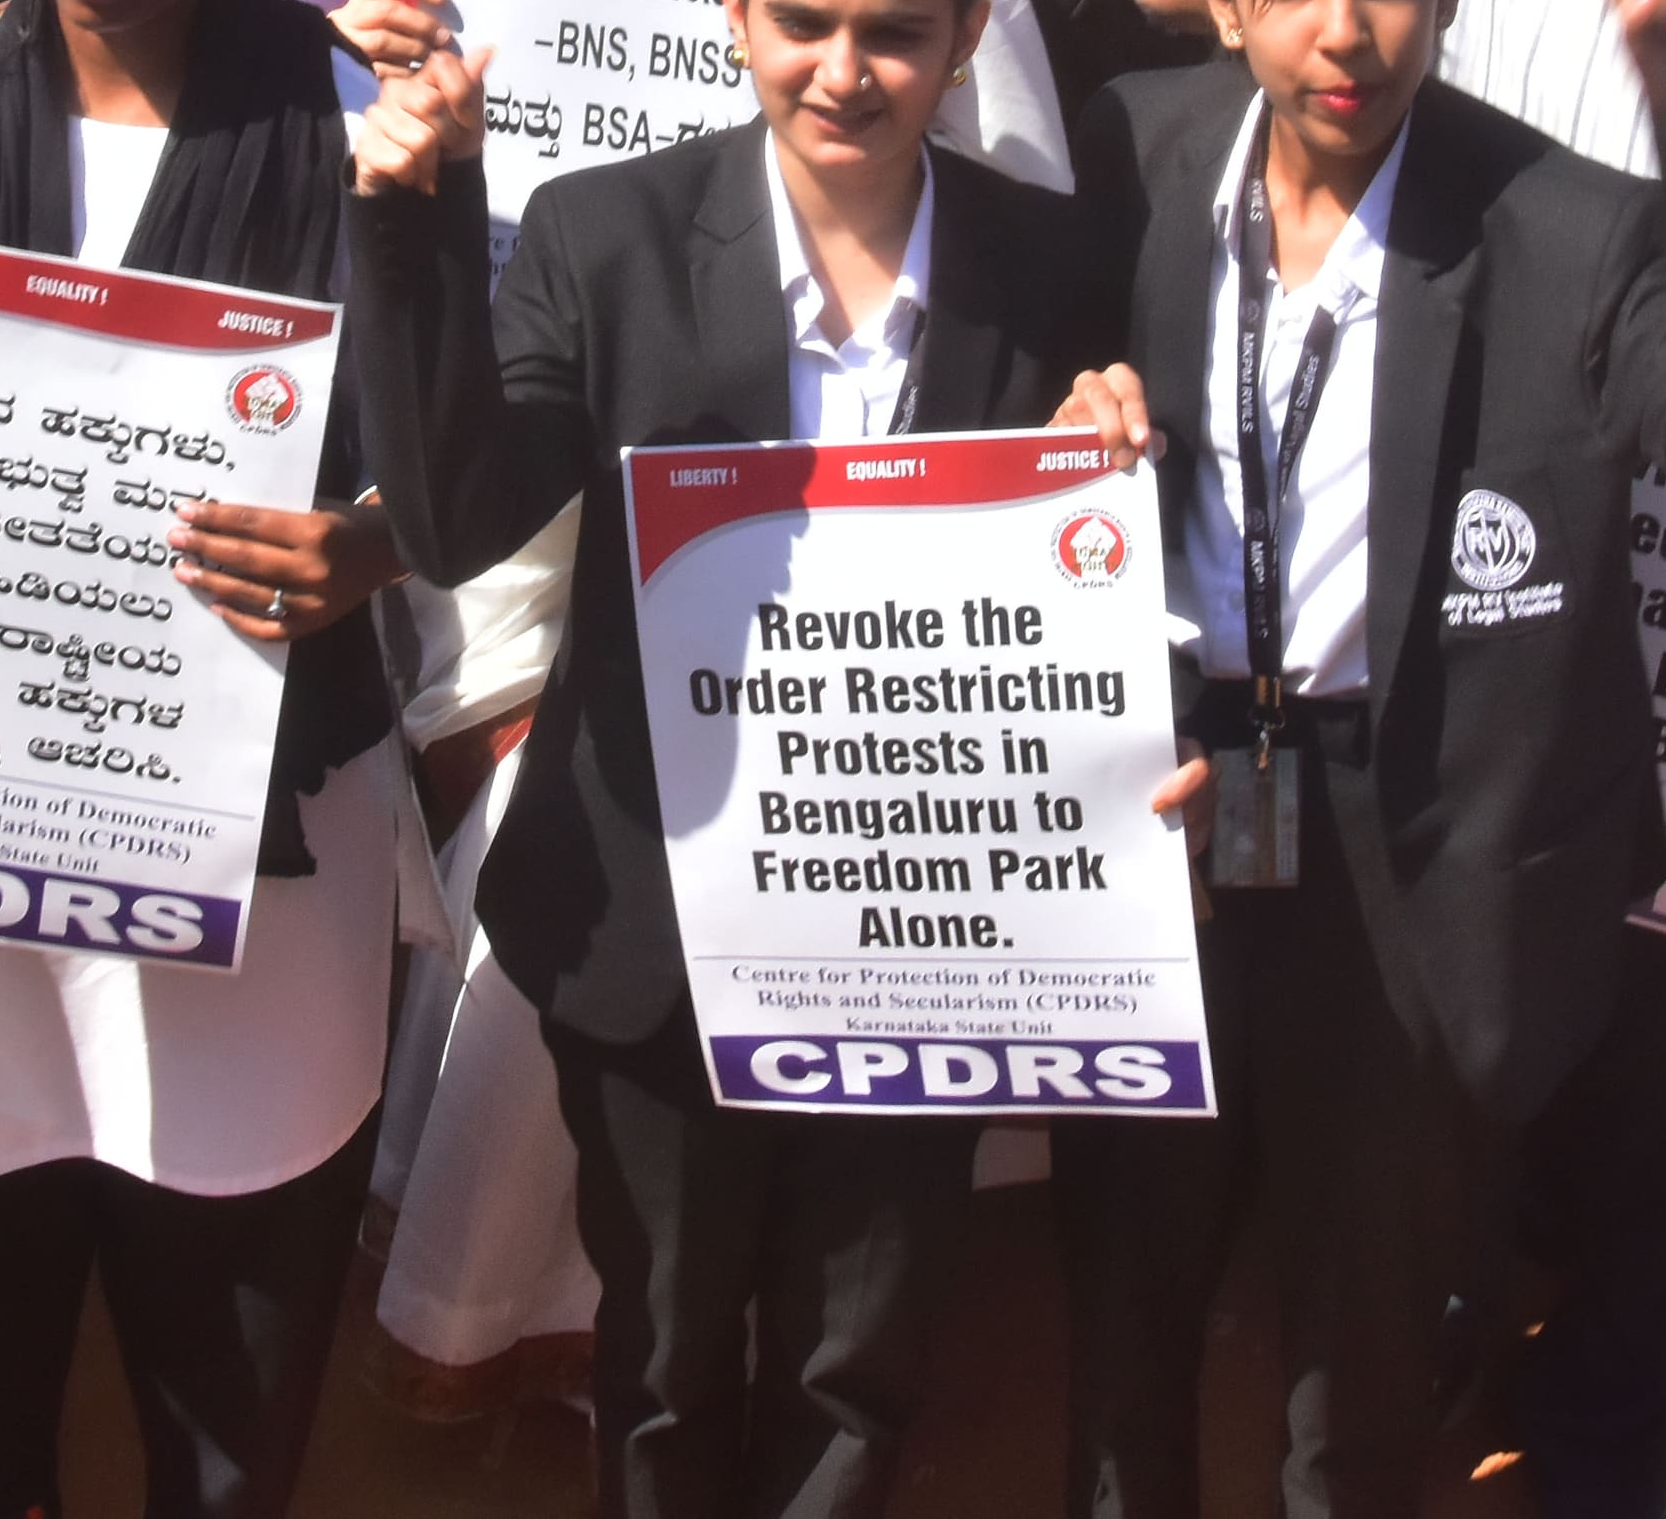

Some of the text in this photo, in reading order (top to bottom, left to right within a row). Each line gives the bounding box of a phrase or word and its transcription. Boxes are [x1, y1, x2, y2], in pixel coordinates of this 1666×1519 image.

[757, 596, 1043, 651] Revoke the
[18, 680, 184, 733] ಹಕ್ಕುಗಳ
[689, 662, 1126, 717] Order Restricting
[777, 728, 1049, 775] Protests in
[46, 794, 73, 817] of
[78, 799, 218, 841] Democratic
[758, 790, 1083, 839] Bengaluru to
[1, 843, 50, 866] State
[56, 851, 99, 875] Unit
[77, 827, 191, 866] (CPDRS)
[751, 845, 1108, 894] Freedom Park
[858, 907, 1014, 949] Alone.
[732, 963, 1156, 988] Centre for Protection of Democratic
[756, 988, 1137, 1014] Rights and Secularism (CPDRS)
[749, 1039, 1172, 1101] CPDRS
